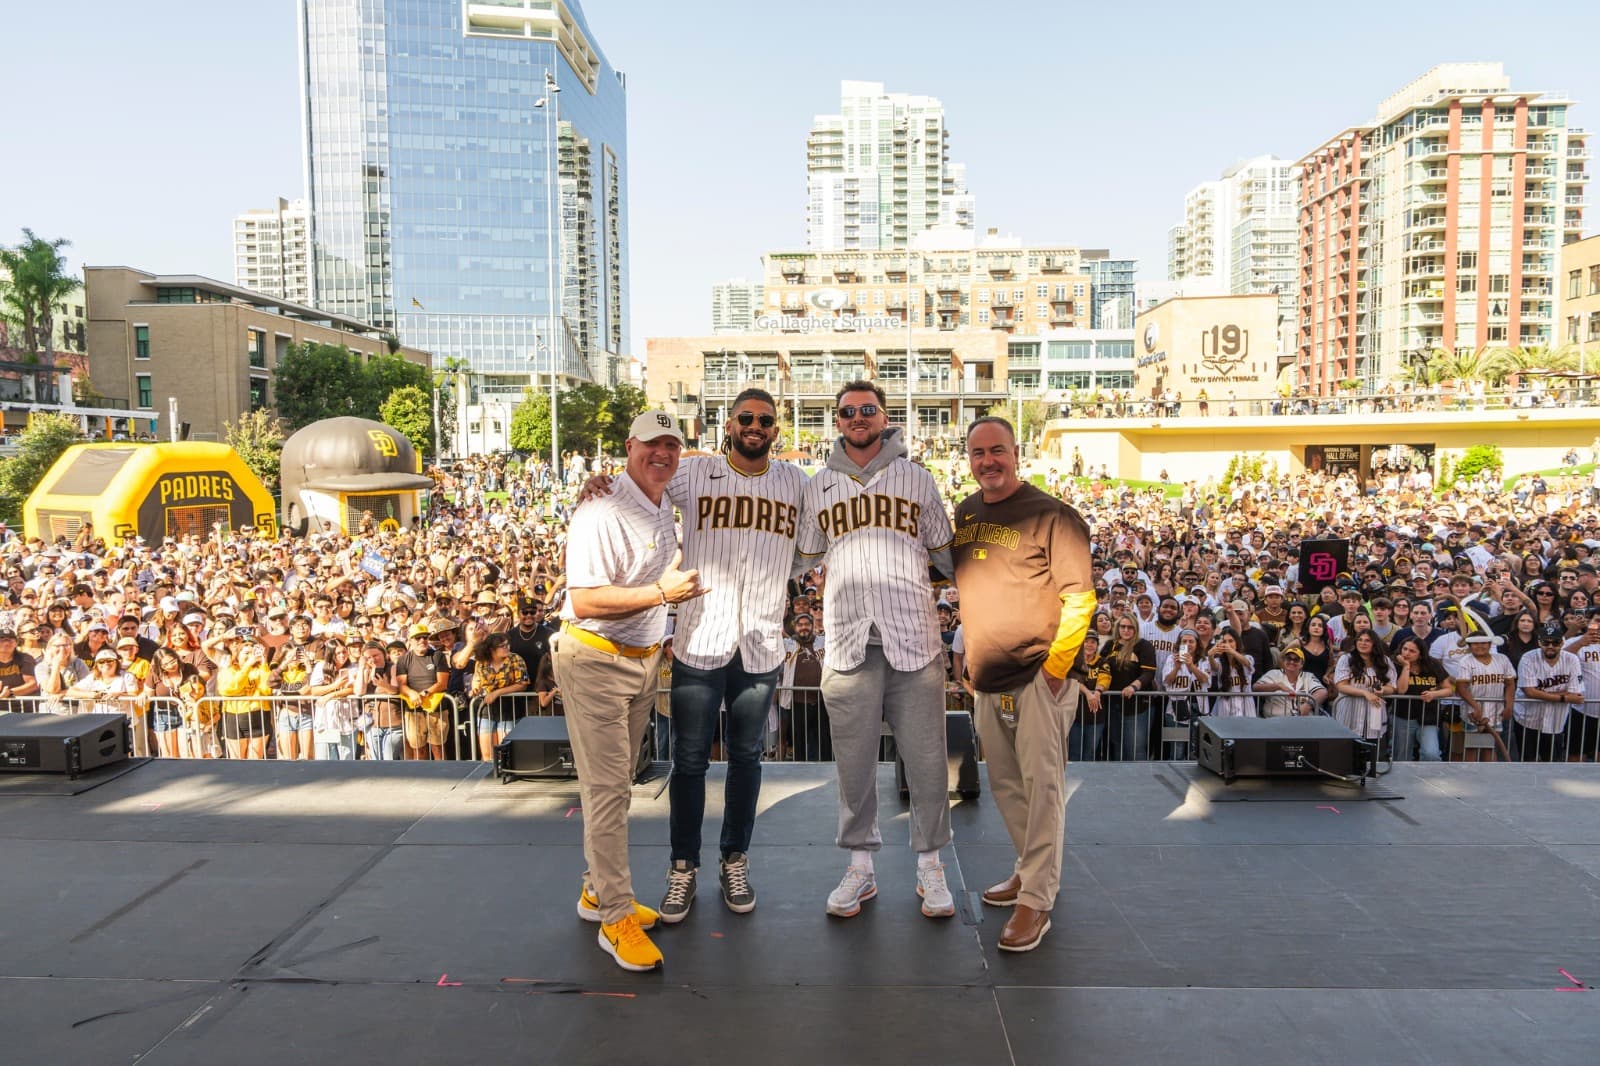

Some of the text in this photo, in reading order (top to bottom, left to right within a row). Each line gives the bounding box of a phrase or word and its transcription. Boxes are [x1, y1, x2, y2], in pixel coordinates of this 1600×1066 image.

[757, 315, 900, 332] Gallagher Square
[1211, 324, 1241, 355] 19
[368, 430, 398, 456] SD
[159, 475, 234, 504] PADRES
[697, 496, 797, 539] PADRES
[817, 493, 921, 538] PADRES
[977, 523, 1020, 551] DIEGO
[1309, 552, 1337, 581] SD
[1471, 673, 1505, 686] PADRES
